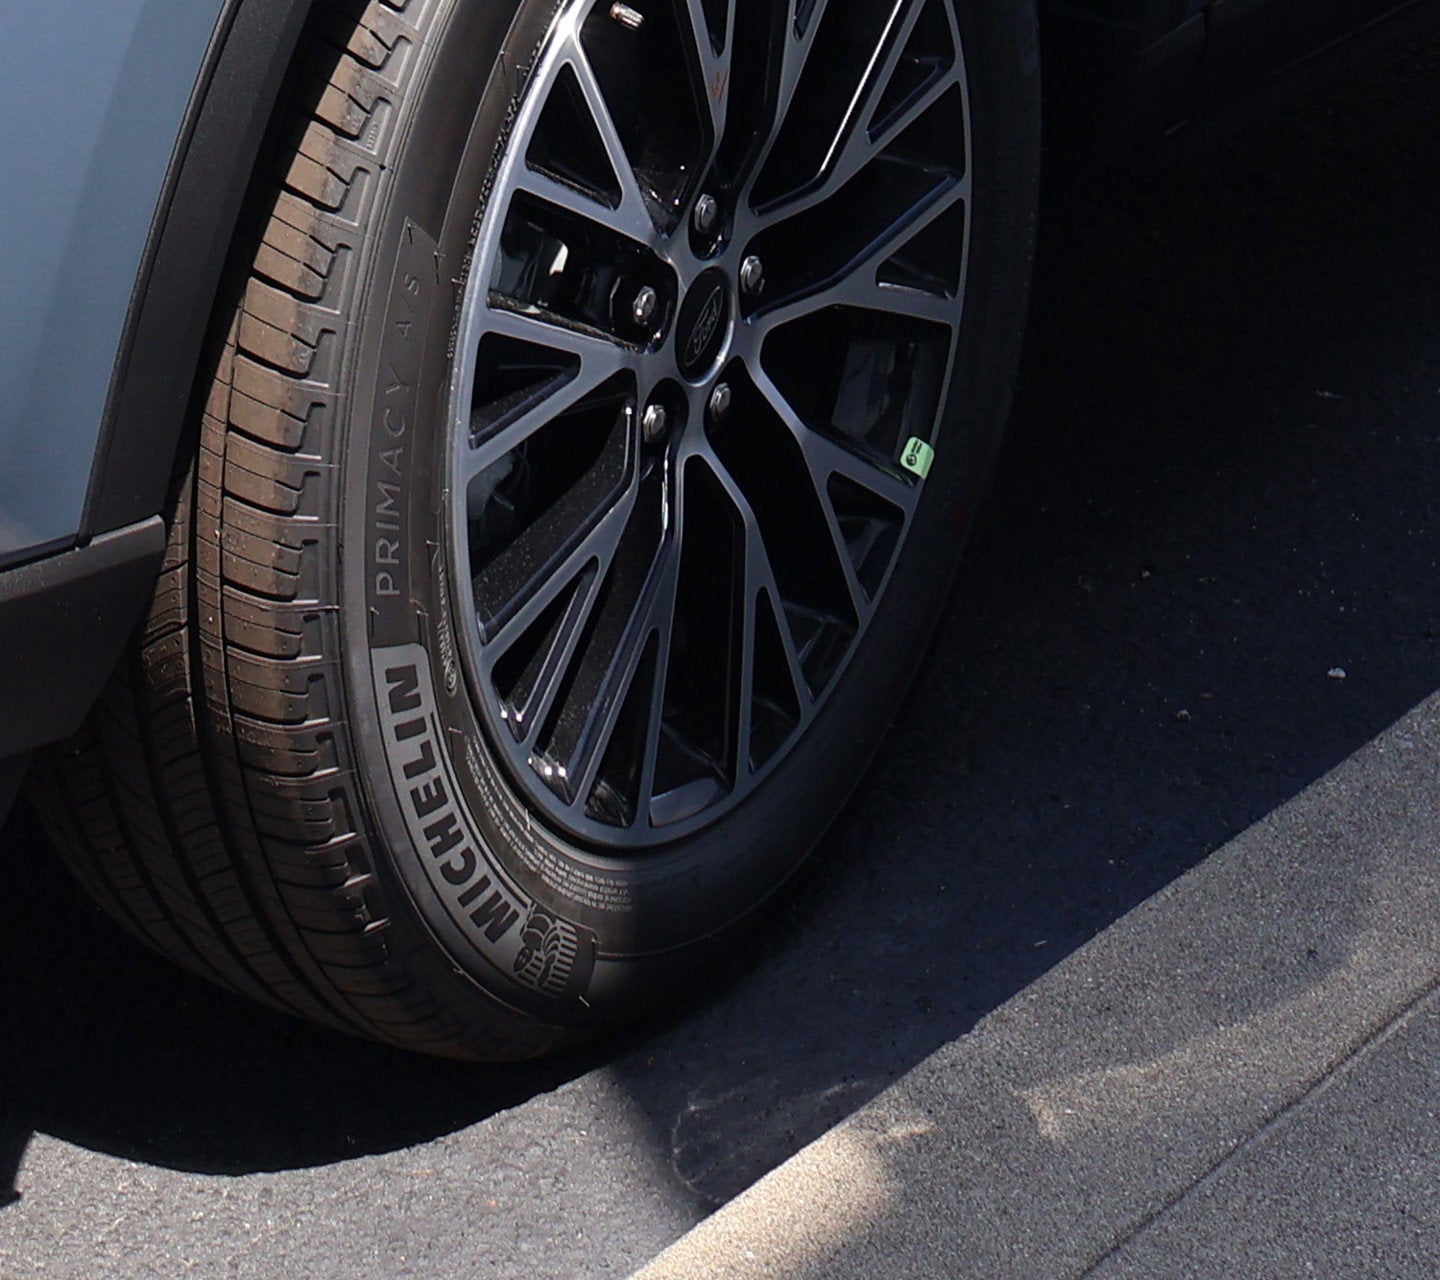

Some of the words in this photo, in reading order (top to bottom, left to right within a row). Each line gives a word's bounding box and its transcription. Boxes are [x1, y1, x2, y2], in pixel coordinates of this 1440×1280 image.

[375, 363, 410, 597] PRIMACY
[394, 272, 420, 340] A/S
[384, 662, 521, 945] MICHELIN
